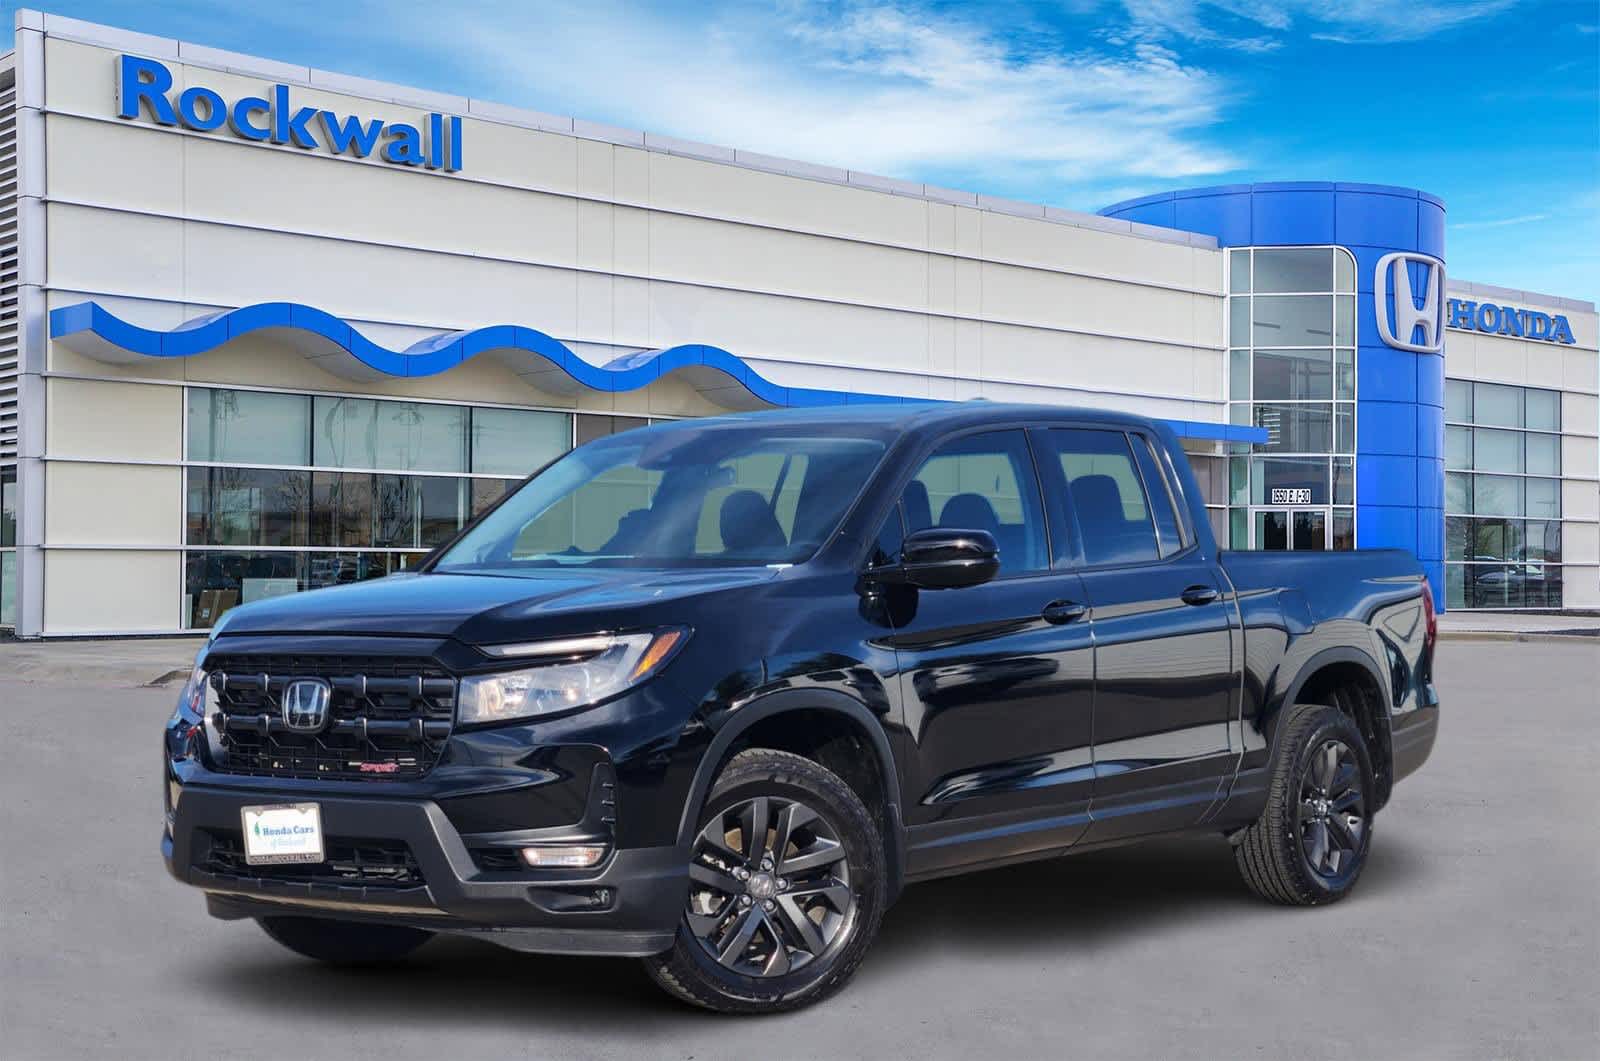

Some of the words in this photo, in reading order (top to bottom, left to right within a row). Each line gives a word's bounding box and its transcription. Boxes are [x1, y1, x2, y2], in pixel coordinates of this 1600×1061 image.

[117, 54, 463, 172] Rockwall
[1447, 298, 1576, 344] HONDA
[263, 826, 292, 837] Honda
[293, 825, 314, 834] Cars
